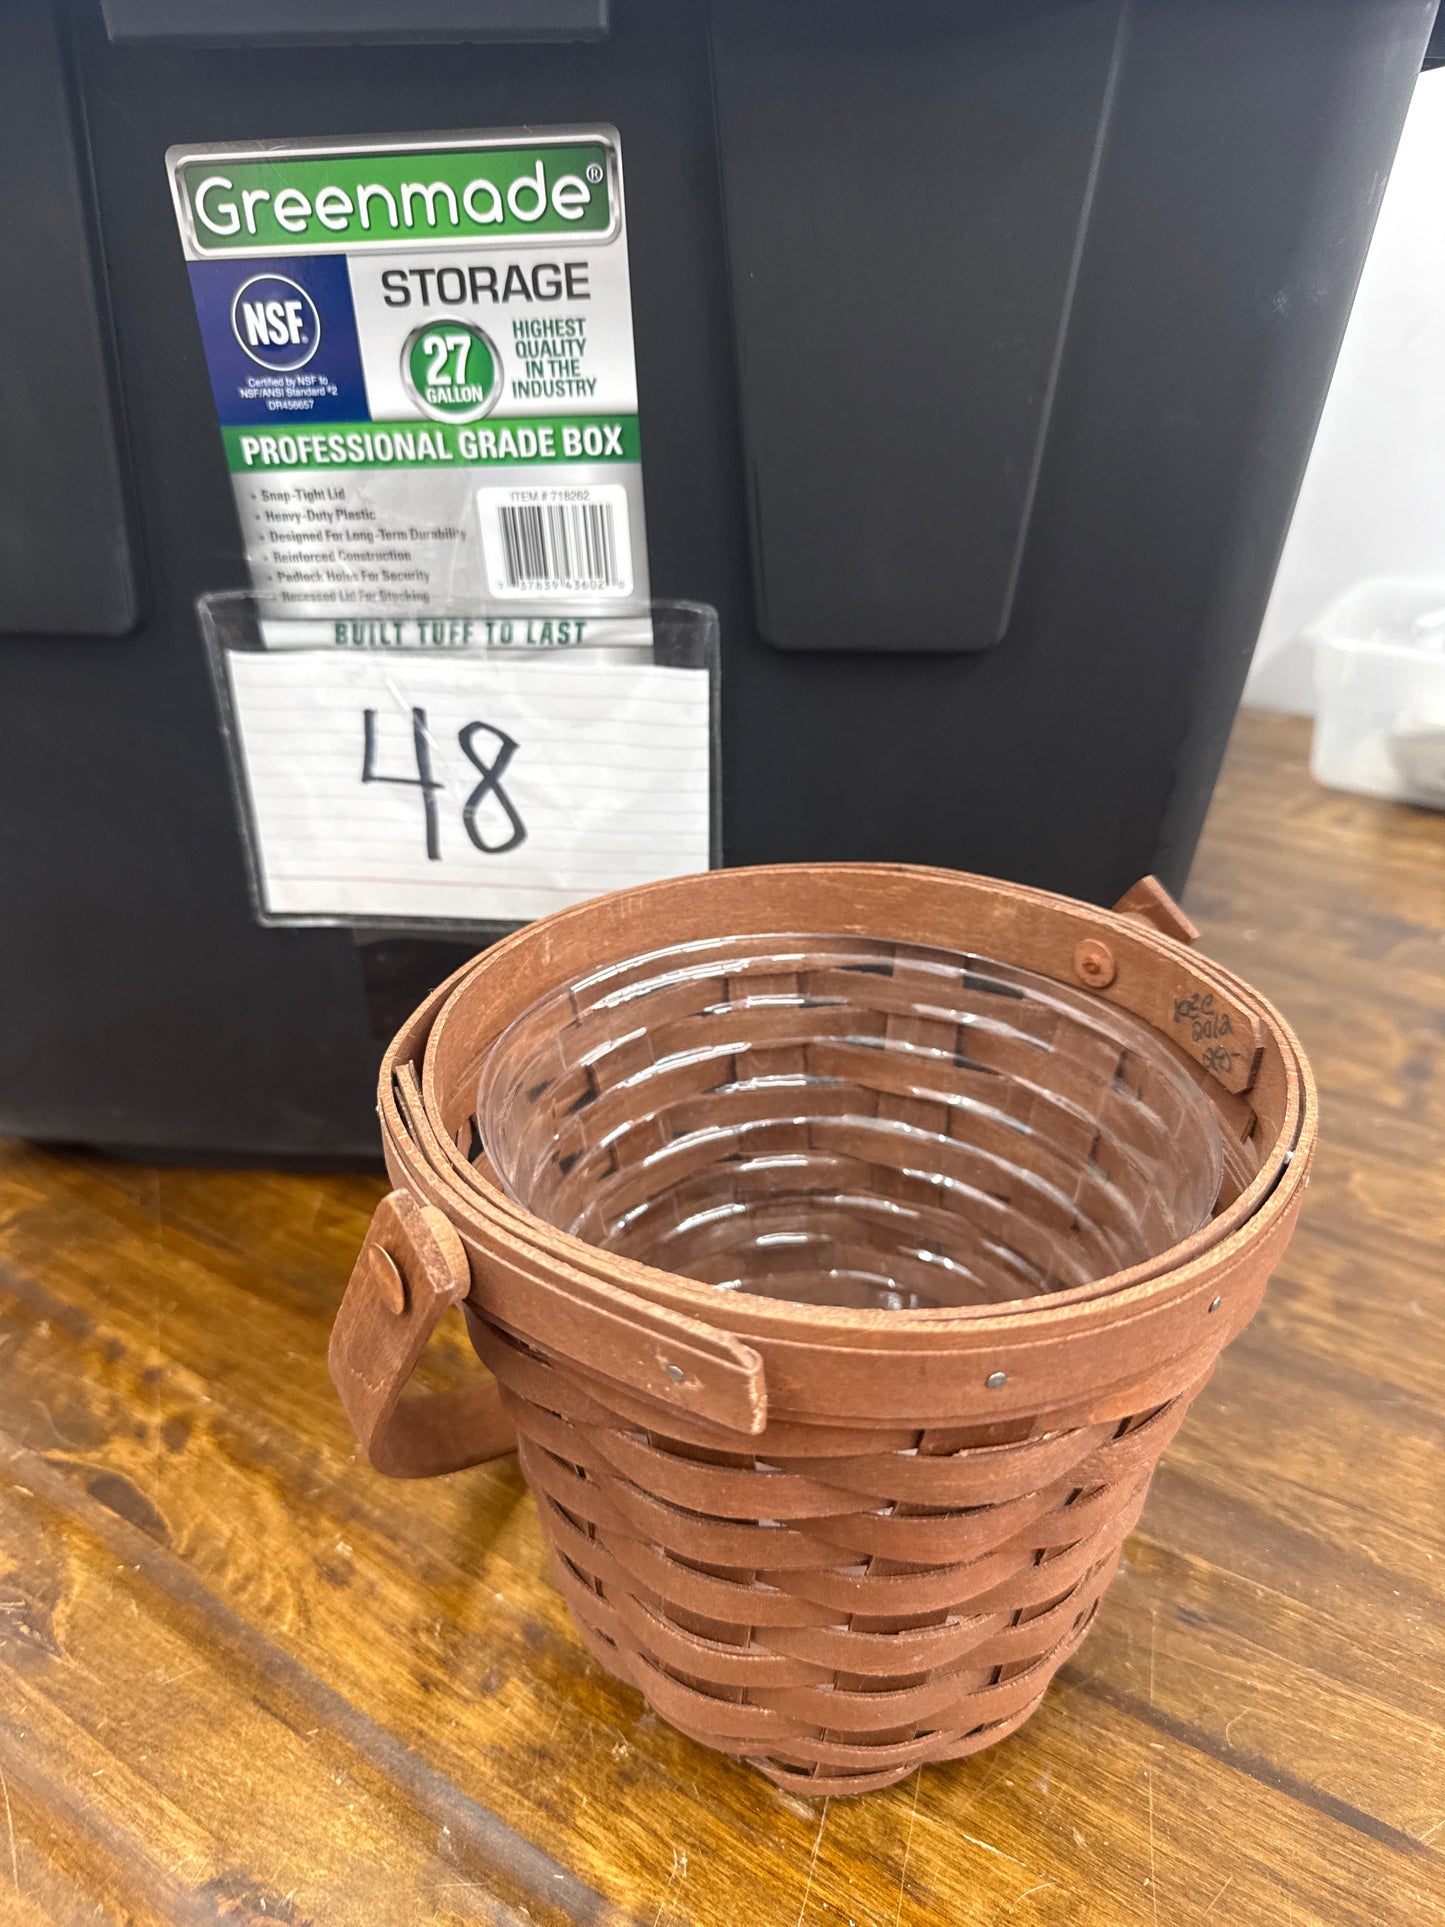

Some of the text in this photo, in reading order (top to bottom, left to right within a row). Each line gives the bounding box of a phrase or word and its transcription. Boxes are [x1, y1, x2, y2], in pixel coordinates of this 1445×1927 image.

[382, 262, 591, 307] STORAGE
[242, 302, 304, 347] NSF
[512, 319, 586, 338] HIGHEST
[515, 338, 588, 358] QUALITY
[425, 336, 471, 385] 27
[526, 358, 580, 378] IN THE
[248, 375, 328, 388] Certified by NSF to
[512, 378, 597, 399] INDUSTRY
[240, 387, 284, 399] NSF/ANSI
[286, 386, 325, 397] Standard
[425, 385, 483, 404] GALLON
[241, 424, 623, 465] PROFESSIONAL GRADE BOX
[261, 488, 345, 504] Snap-Tight Lid
[510, 491, 538, 502] ITEM
[265, 509, 376, 524] Heavy-Duty Plastic
[269, 527, 467, 544] Designed For Long-Term Durability
[273, 551, 412, 563] Reinforced Construction
[277, 570, 323, 583] Padlock
[361, 569, 379, 581] For
[382, 568, 430, 583] Security
[339, 591, 358, 602] Lid
[359, 591, 378, 602] For
[334, 620, 588, 646] BUILT TUFF TO LAST
[362, 707, 528, 861] 48
